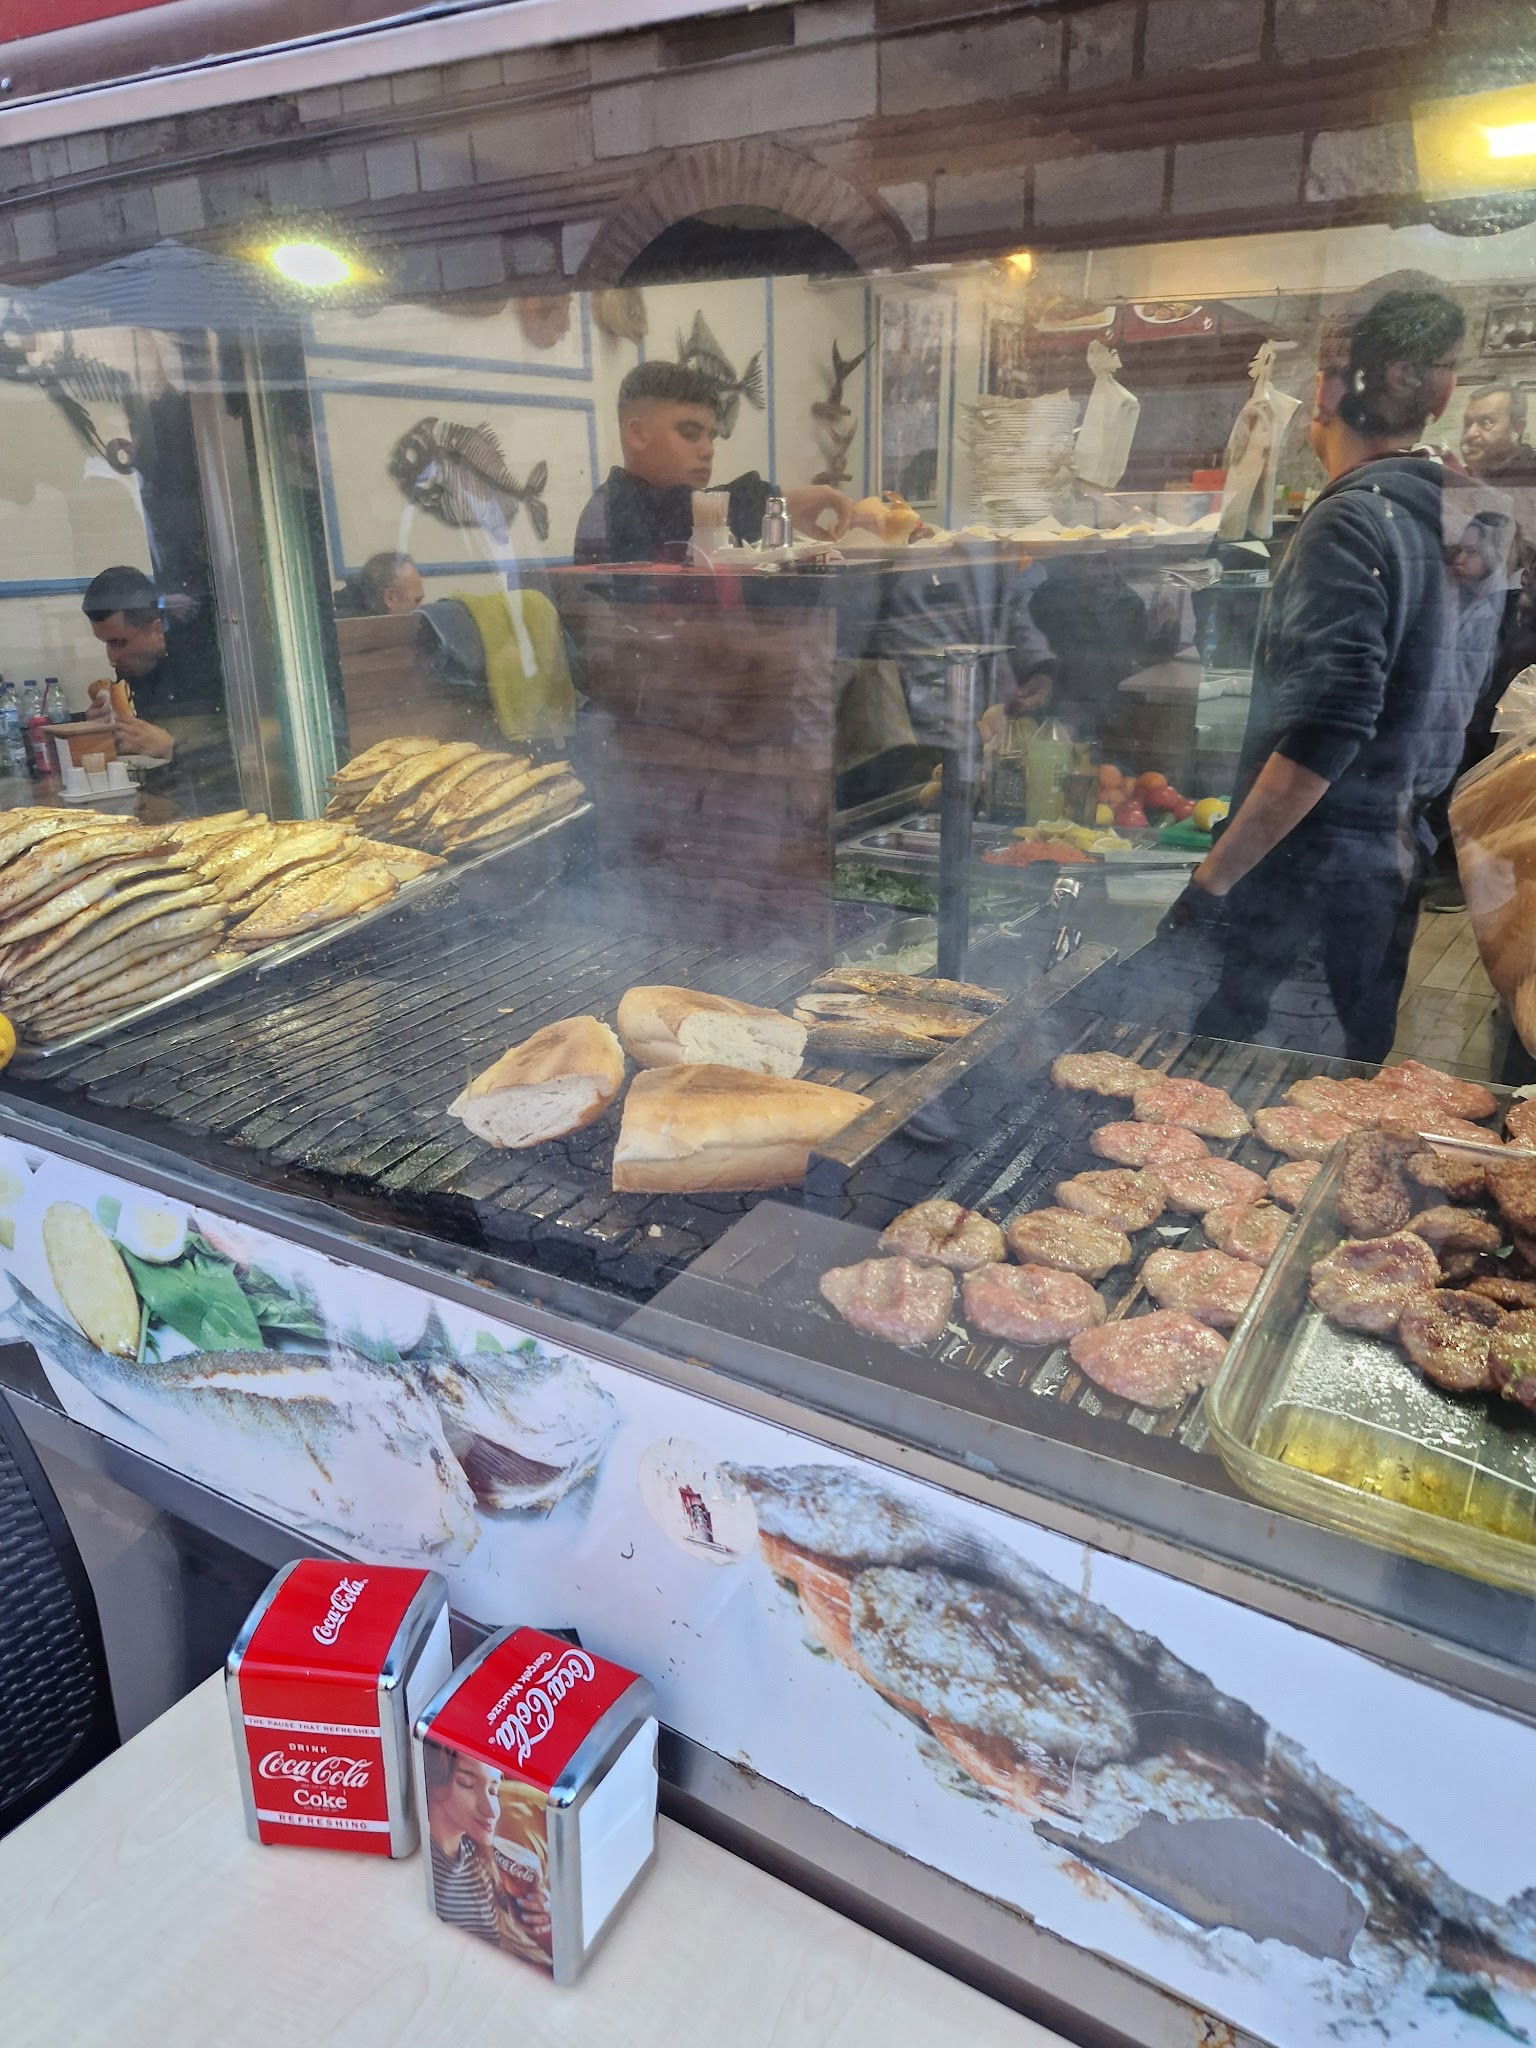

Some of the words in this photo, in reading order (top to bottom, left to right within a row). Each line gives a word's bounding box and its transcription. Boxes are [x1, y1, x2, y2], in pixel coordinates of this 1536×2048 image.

[312, 1576, 367, 1646] Coca-Cola
[518, 1651, 553, 1684] Gerçek
[494, 1648, 596, 1769] Coca-Cola
[248, 1717, 264, 1726] THE
[267, 1720, 296, 1729] PAUSE
[299, 1723, 321, 1732] THAT
[323, 1725, 377, 1736] REFRESHES
[288, 1742, 329, 1754] DRINK
[258, 1750, 374, 1788] Coca-Cola
[293, 1788, 348, 1810] Coke
[278, 1814, 369, 1830] REFRESHING
